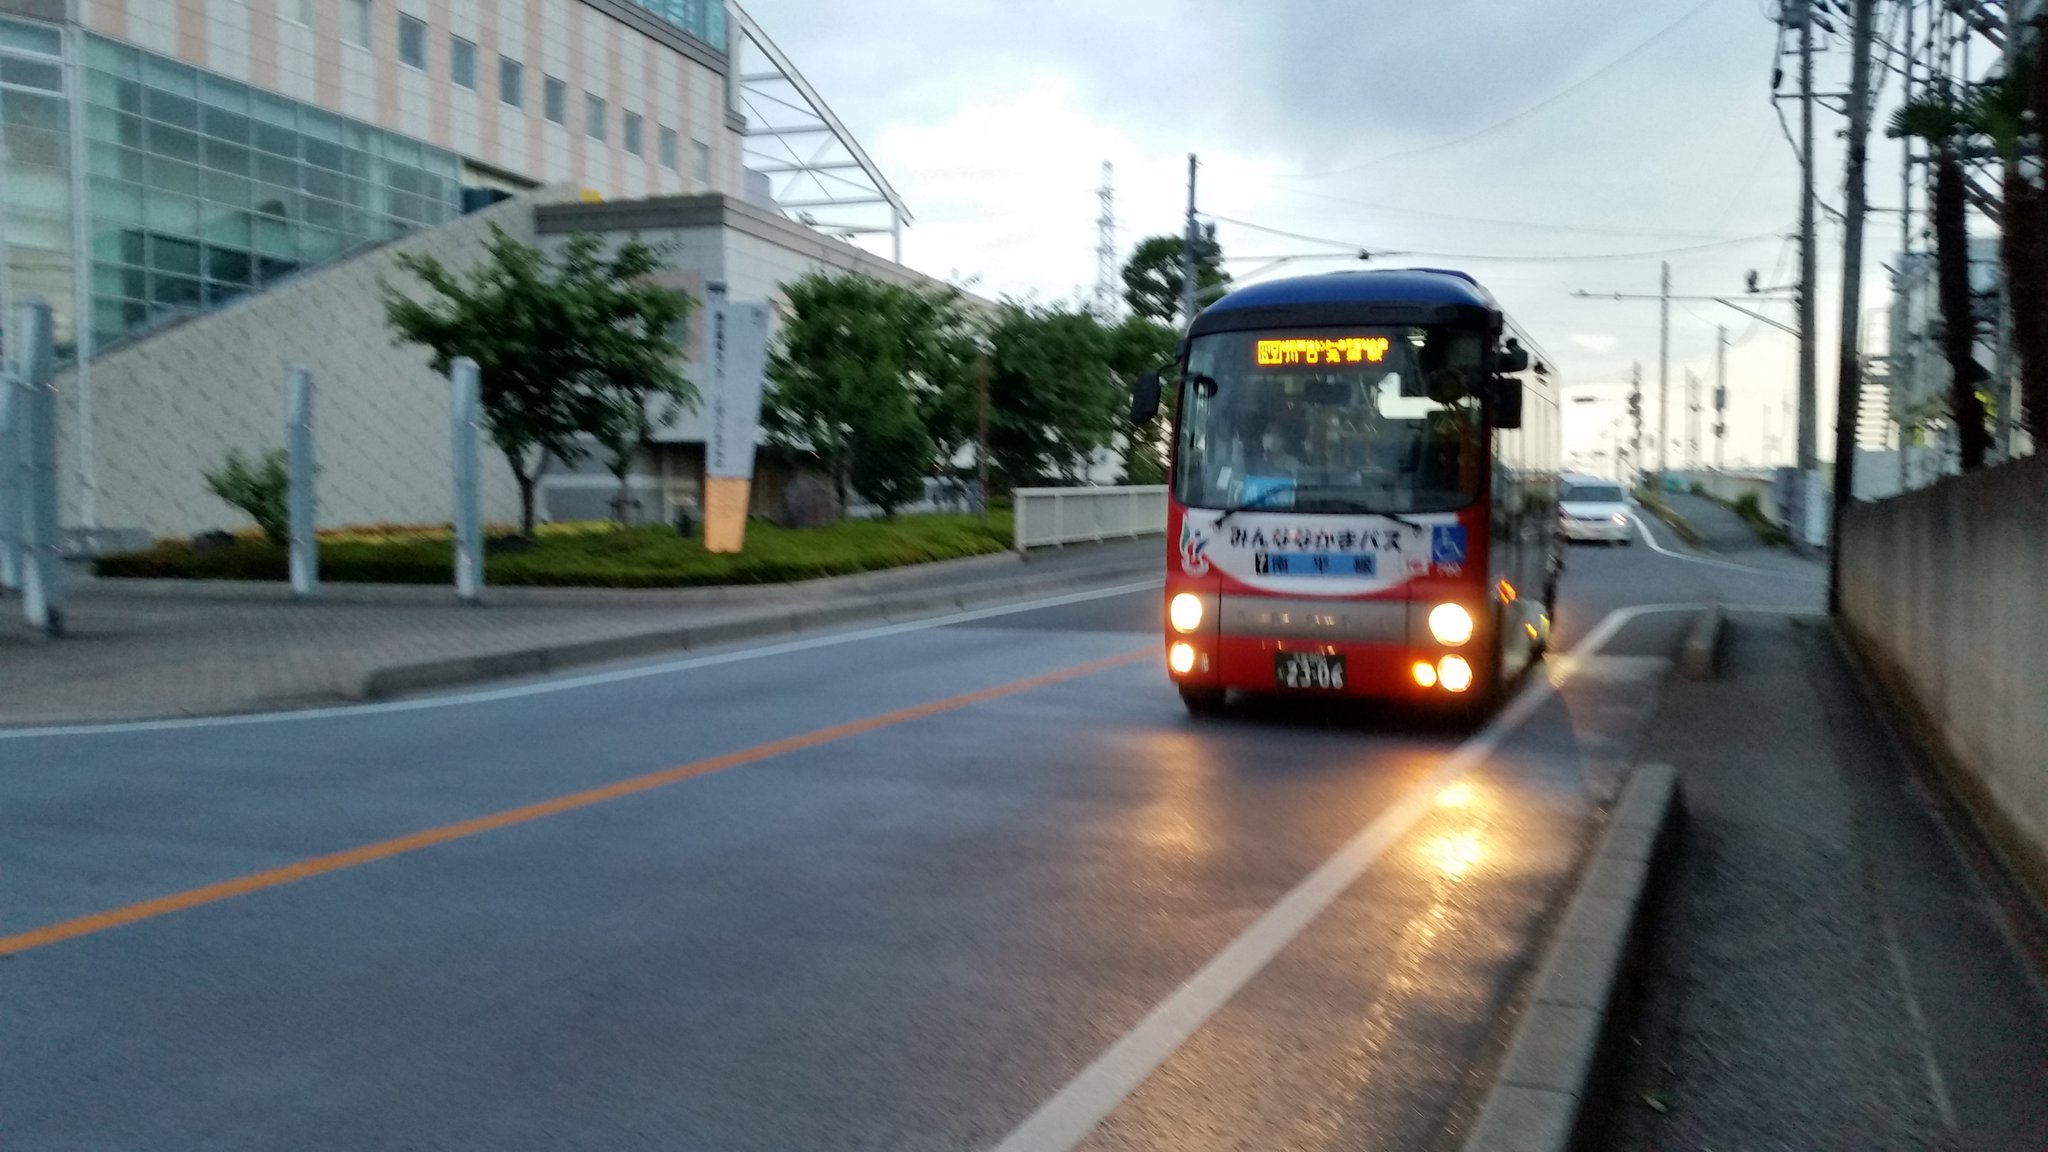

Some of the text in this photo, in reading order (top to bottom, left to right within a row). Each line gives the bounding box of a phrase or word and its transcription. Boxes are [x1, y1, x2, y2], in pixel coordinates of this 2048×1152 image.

[1230, 526, 1401, 552] みんななかまバス
